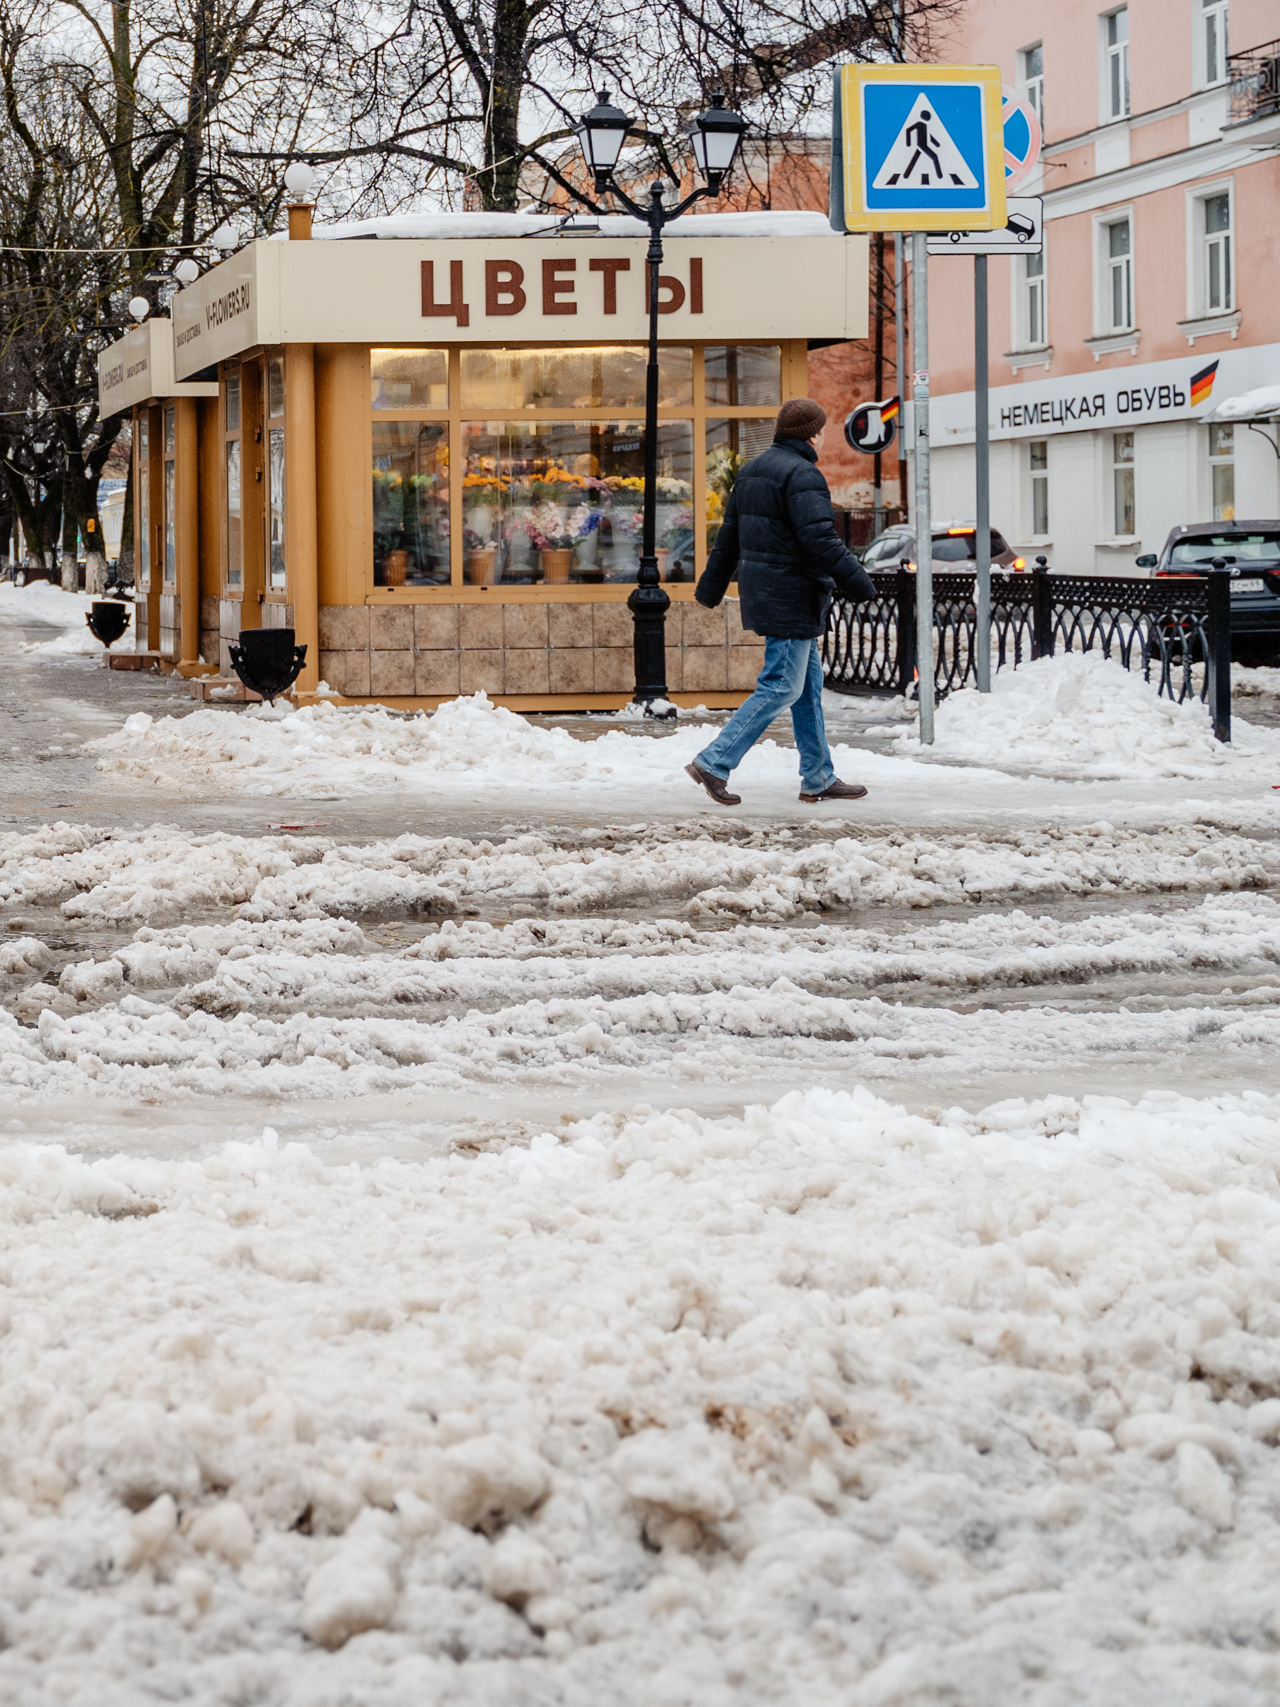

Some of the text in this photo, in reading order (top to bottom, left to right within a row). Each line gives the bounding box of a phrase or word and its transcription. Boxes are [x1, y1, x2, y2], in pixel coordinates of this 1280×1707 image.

[206, 281, 250, 330] V-FLOWERS.RU
[421, 257, 703, 327] ЦВЕТЫ
[1000, 393, 1106, 429] НЕМЕЦКАЯ
[1116, 384, 1186, 413] ОБУВЬ
